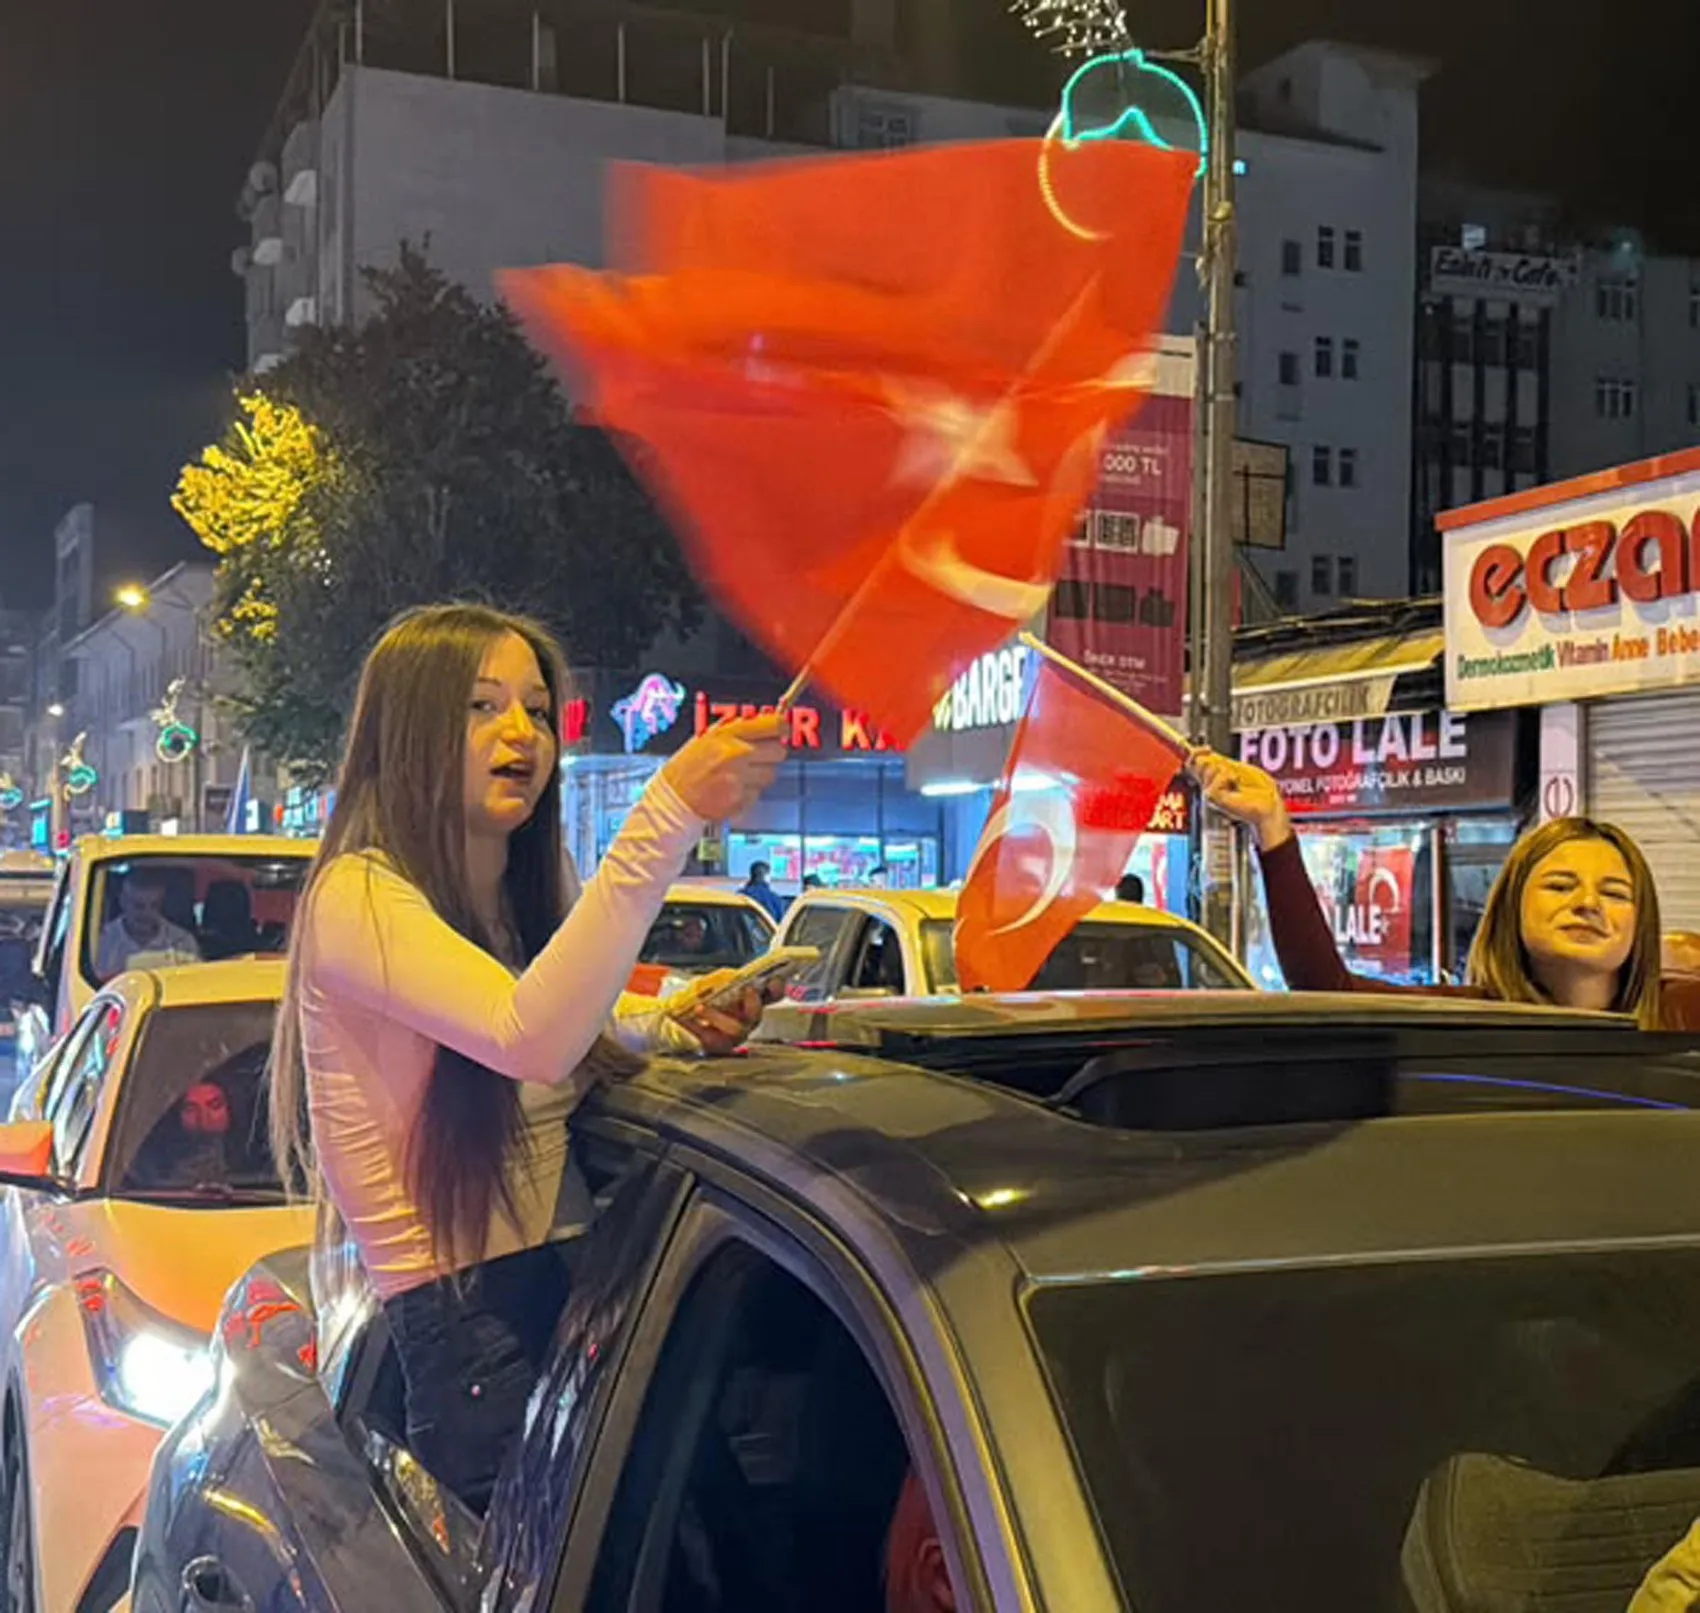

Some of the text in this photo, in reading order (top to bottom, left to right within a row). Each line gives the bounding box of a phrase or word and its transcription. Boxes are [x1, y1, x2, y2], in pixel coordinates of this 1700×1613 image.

[1468, 508, 1700, 629] ecza
[1239, 709, 1468, 773] FOTO LALE
[1334, 904, 1382, 945] LALE
